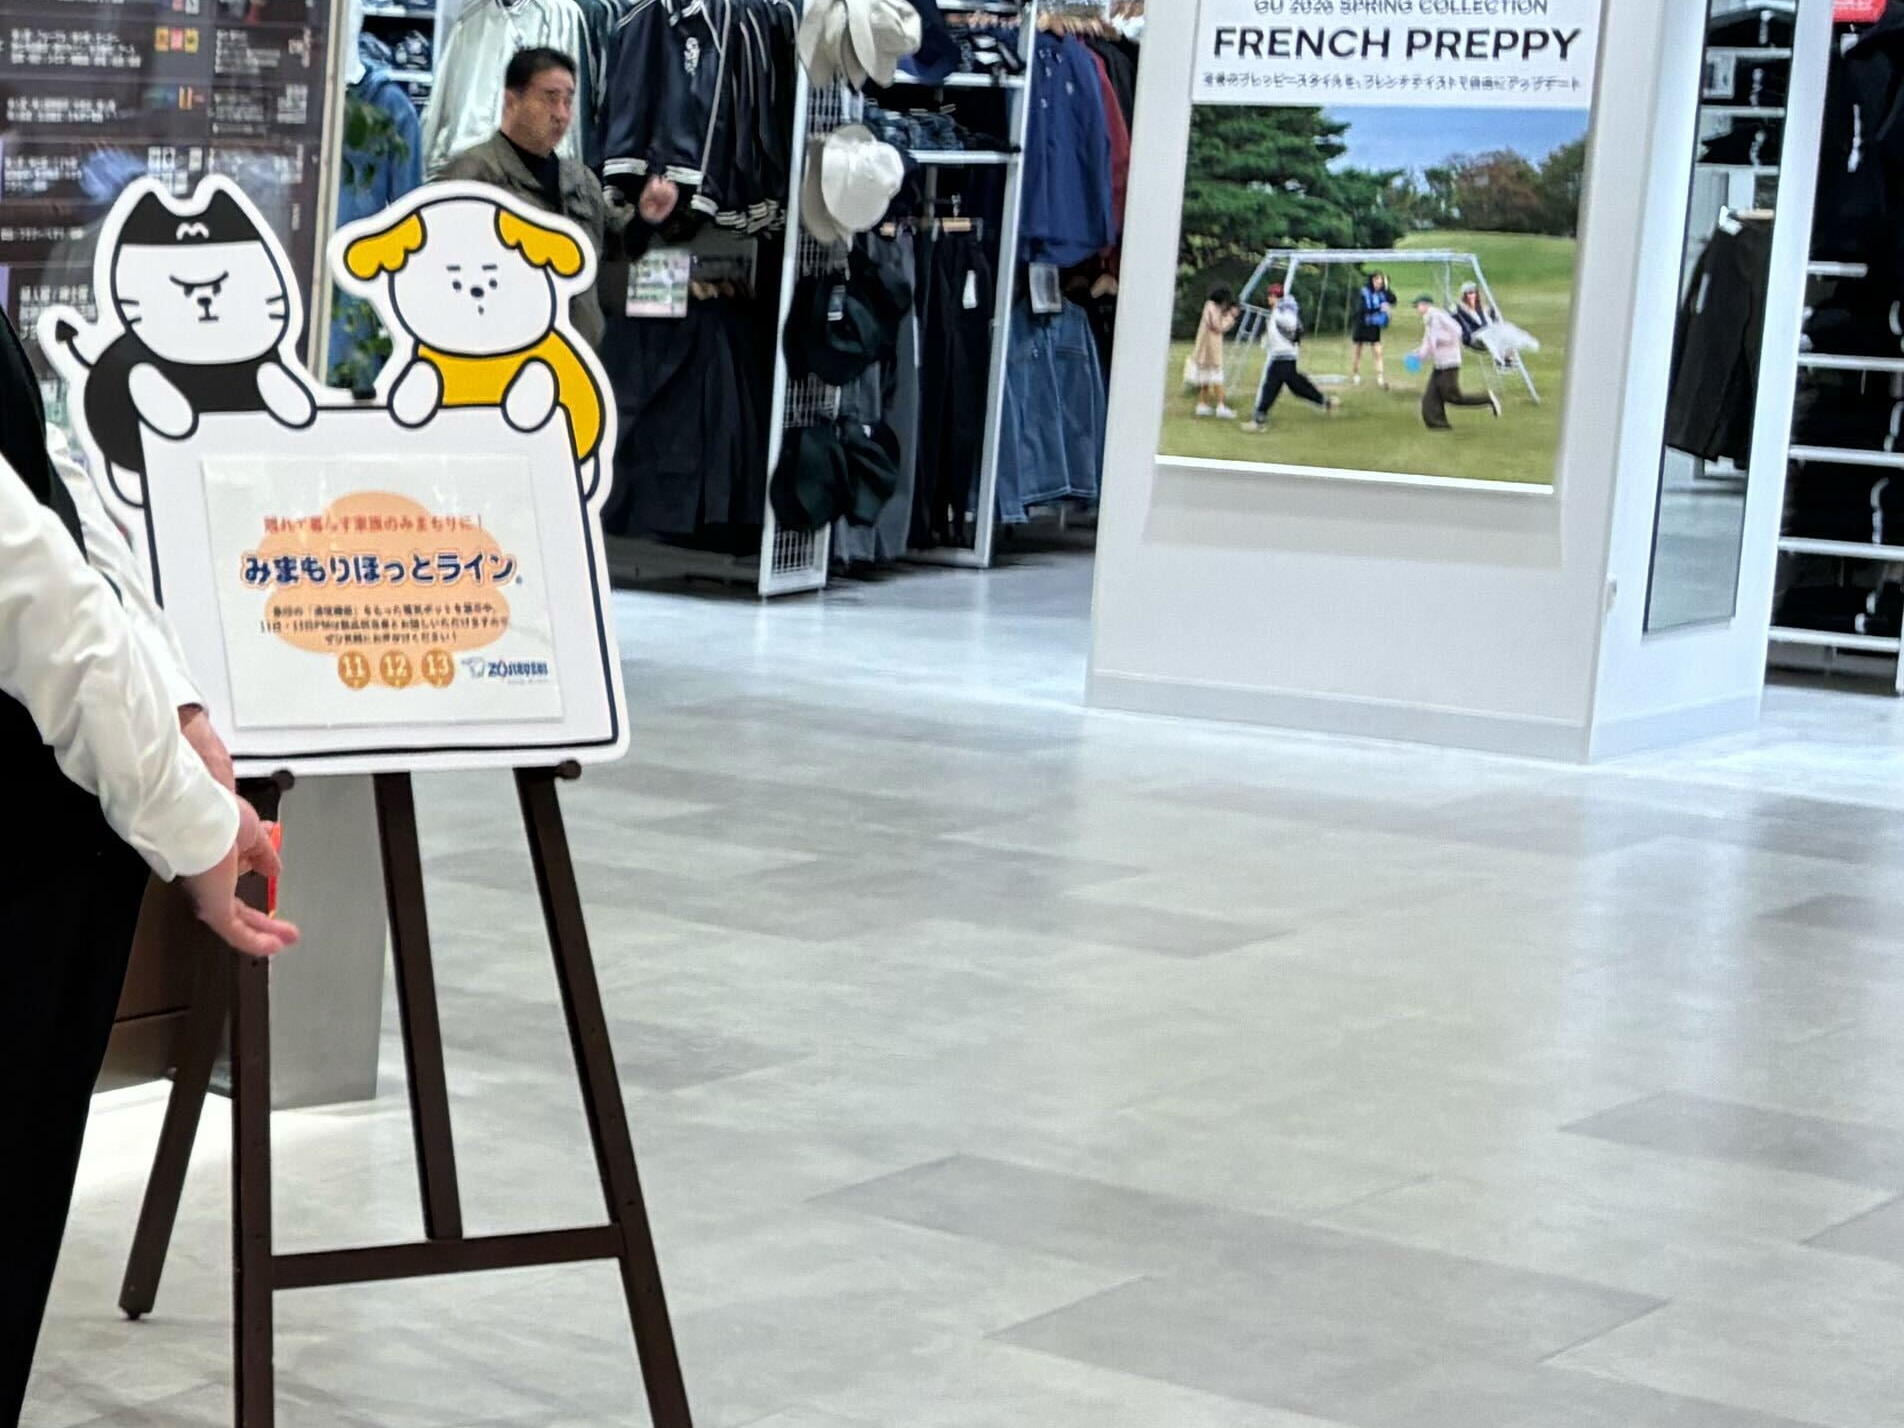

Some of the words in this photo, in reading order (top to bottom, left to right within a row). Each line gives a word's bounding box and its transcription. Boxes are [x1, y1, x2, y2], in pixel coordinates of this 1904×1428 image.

[1213, 26, 1391, 60] FRENCH
[1405, 27, 1583, 61] PREPPY
[243, 551, 516, 584] みまもりほっとライン
